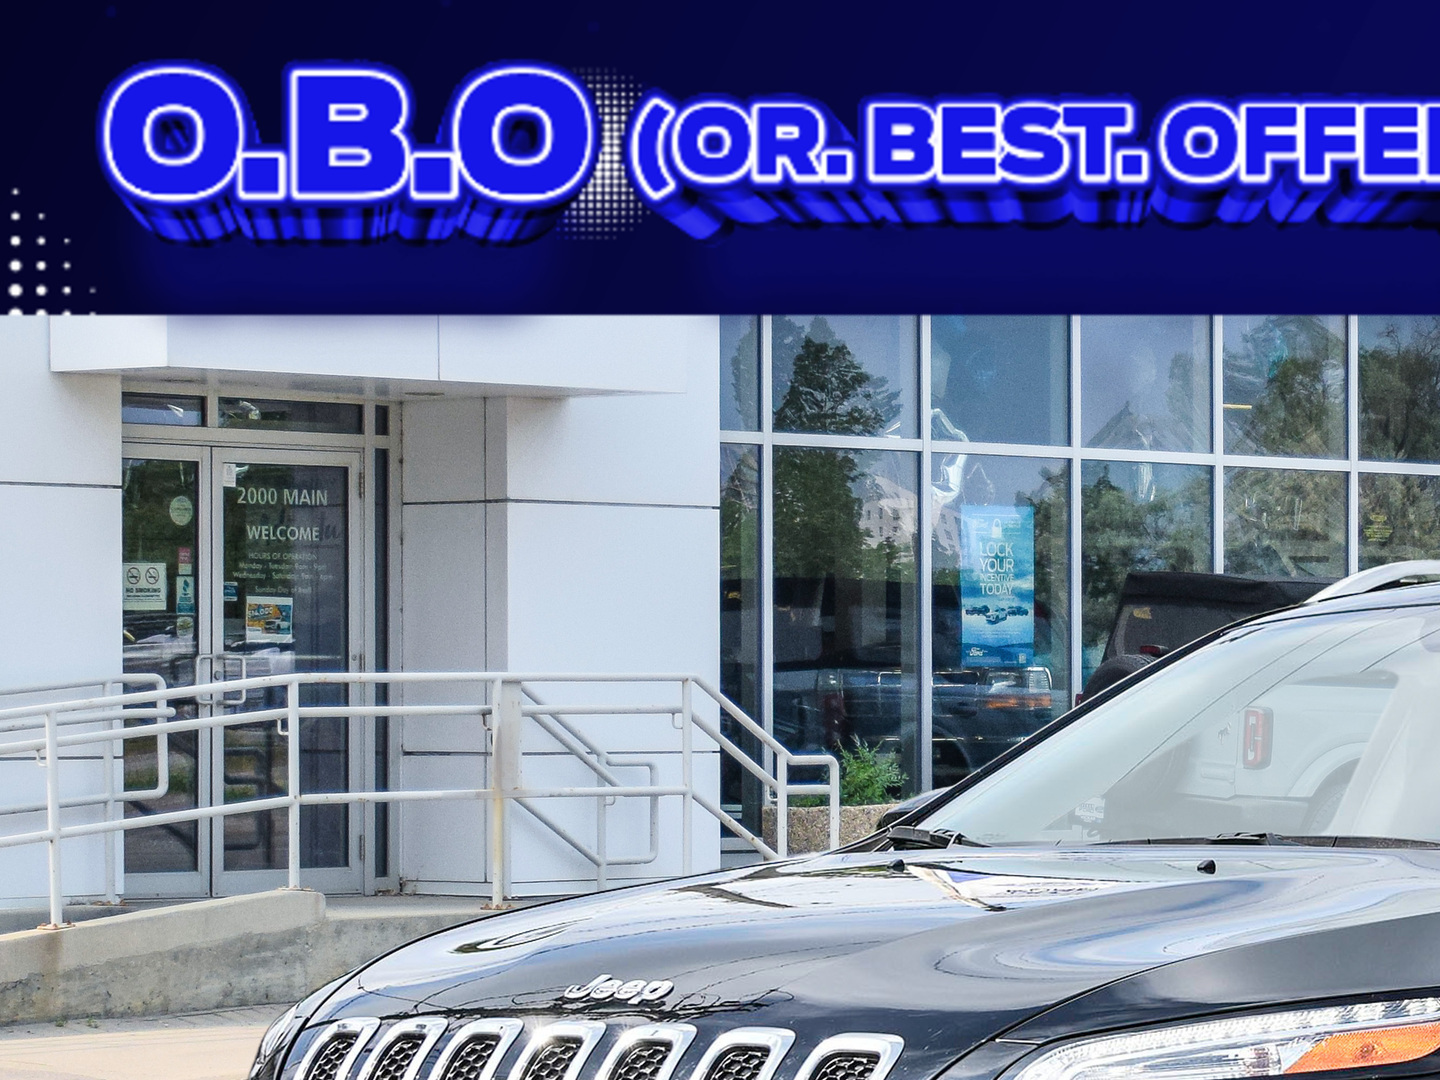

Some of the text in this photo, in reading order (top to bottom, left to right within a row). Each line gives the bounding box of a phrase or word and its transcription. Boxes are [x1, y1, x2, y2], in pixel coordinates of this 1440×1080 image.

[237, 487, 328, 506] 2000 MAIN
[246, 525, 320, 541] WELCOME
[979, 542, 1014, 557] LOCK
[979, 558, 1015, 573] YOUR
[979, 582, 1014, 596] TODAY
[564, 974, 674, 1005] Jeep
